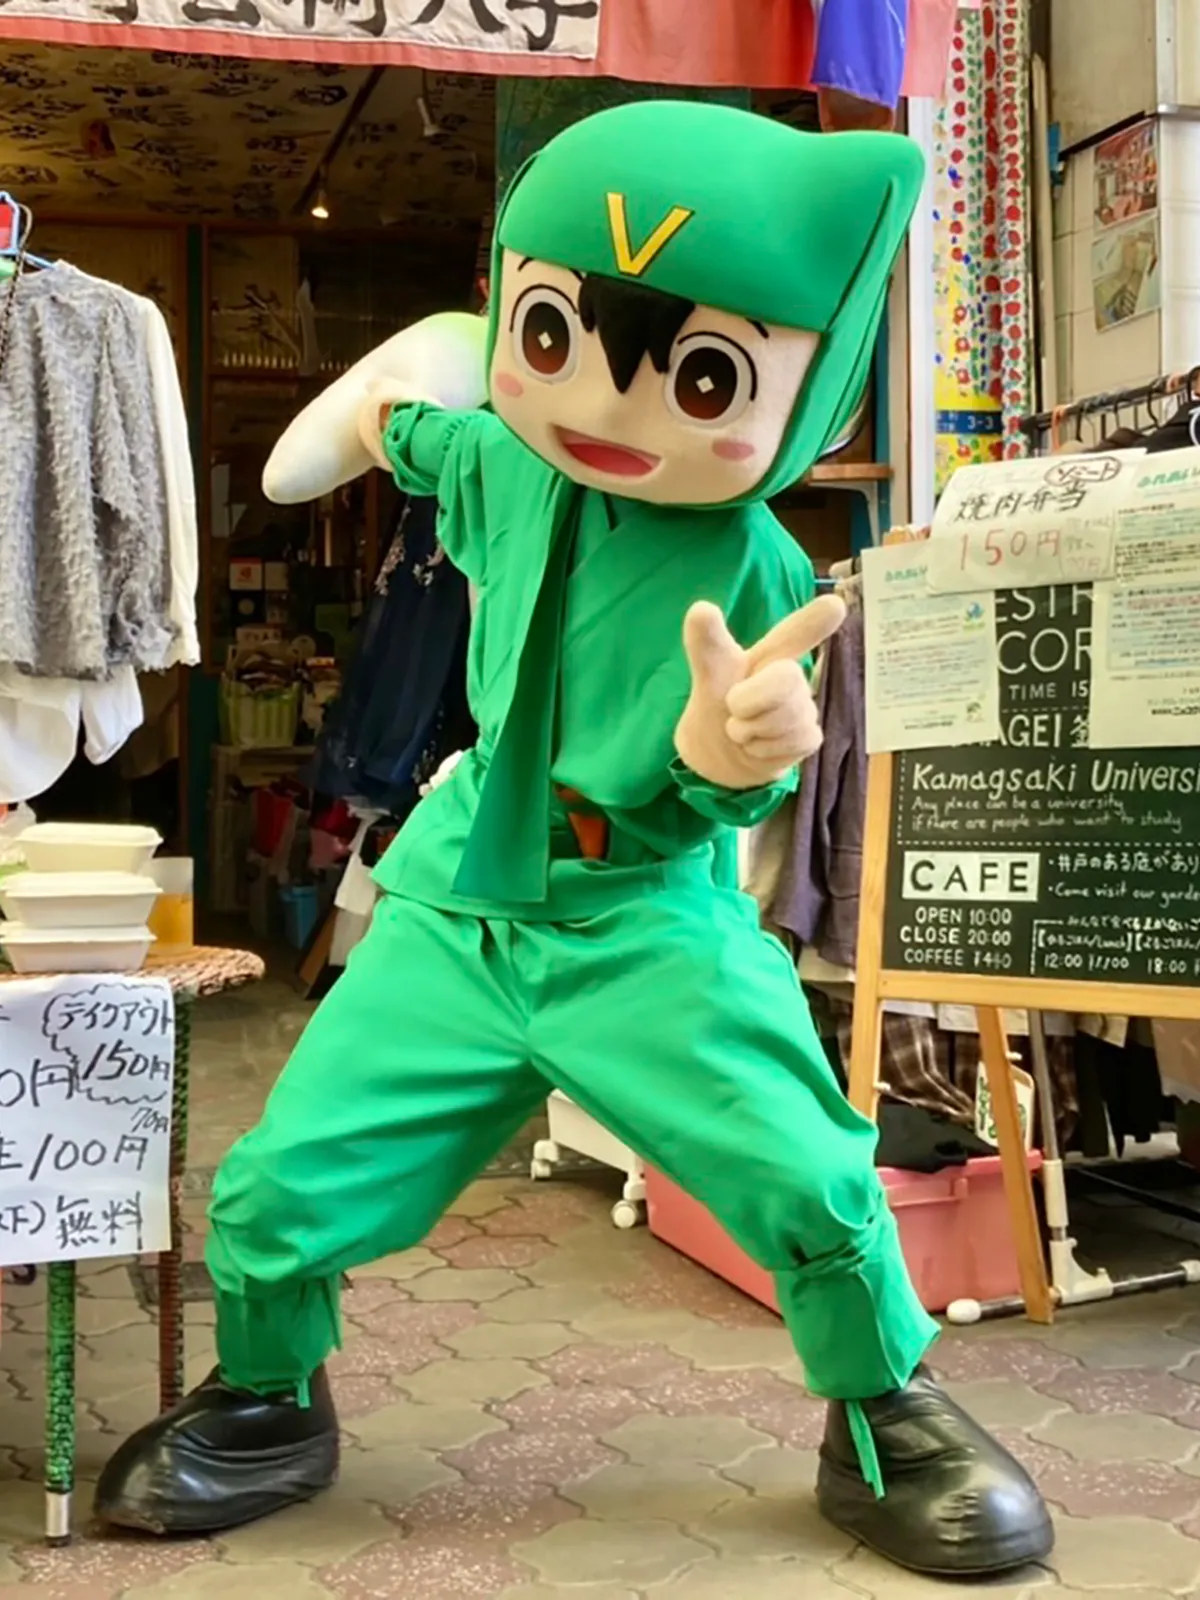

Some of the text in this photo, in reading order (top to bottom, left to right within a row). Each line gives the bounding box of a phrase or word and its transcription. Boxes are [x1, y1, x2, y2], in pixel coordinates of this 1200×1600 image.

[606, 191, 695, 277] V
[954, 479, 1088, 522] 焼肉弁当
[960, 528, 1061, 570] 150円
[1008, 682, 1057, 700] TIME
[912, 763, 1077, 800] Kamagsaki
[911, 792, 1124, 822] Any place can be a university
[965, 819, 987, 829] are
[992, 813, 1029, 832] people
[1073, 811, 1110, 826] want
[1140, 810, 1182, 834] study
[910, 860, 1028, 892] CAFE
[1095, 880, 1127, 898] visit
[1133, 889, 1155, 899] our
[915, 906, 1012, 926] OPEN 10:00
[900, 926, 1012, 946] CLOSE 20:00
[904, 948, 964, 966] COFFEE
[1045, 952, 1083, 968] 12:00
[1147, 956, 1187, 975] 18:00
[58, 997, 174, 1036] テイクアウト
[82, 1038, 171, 1082] 150円
